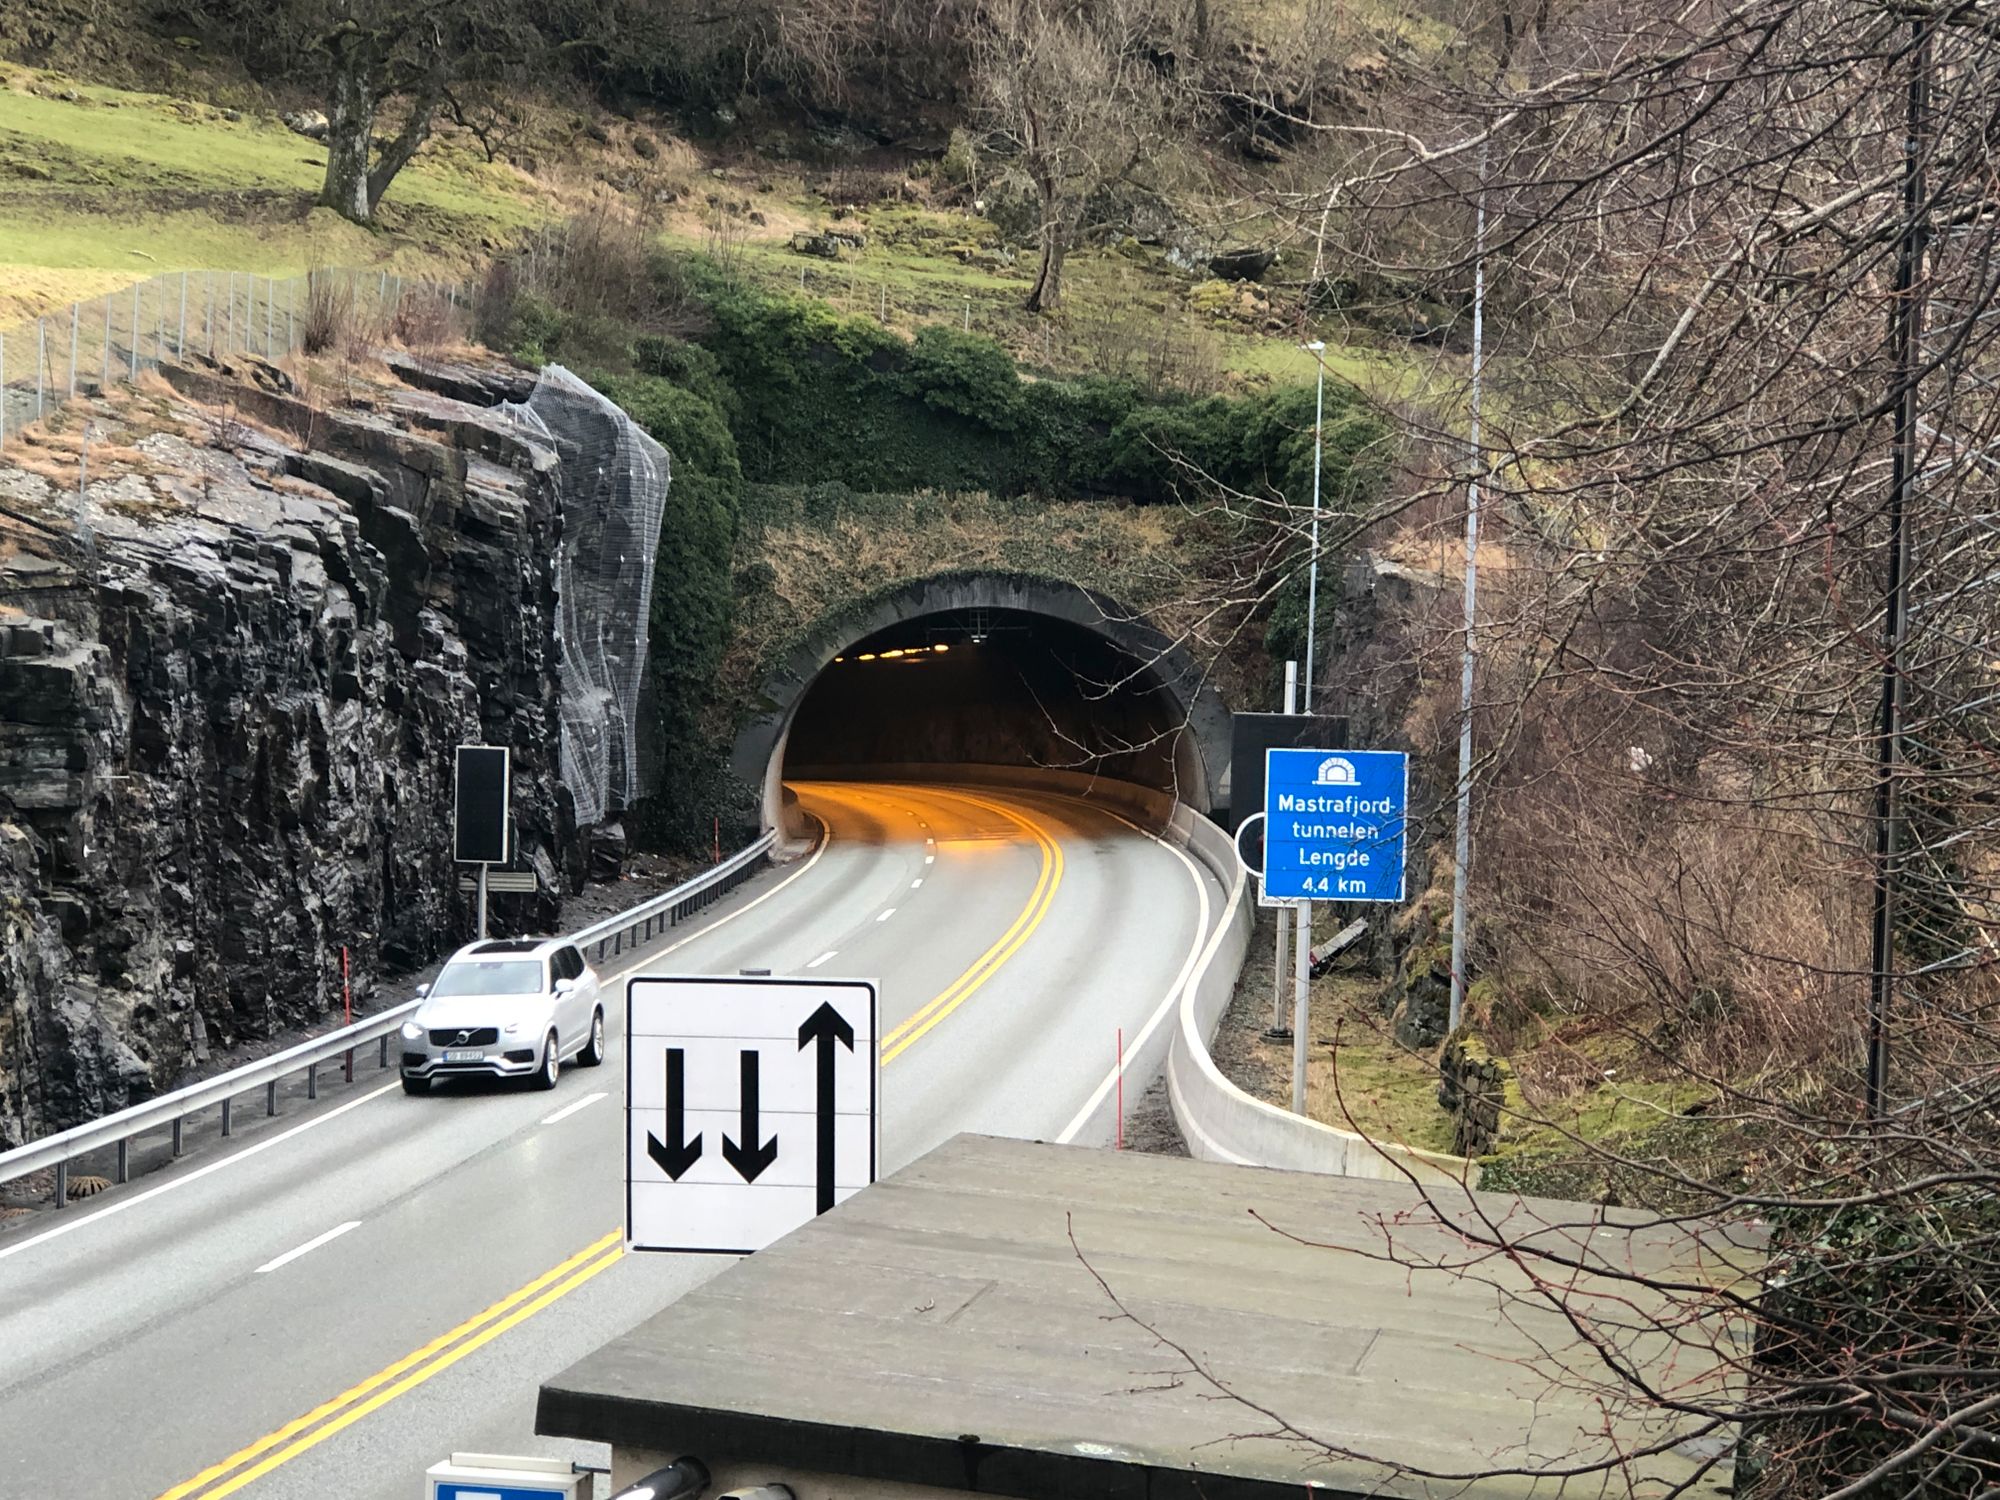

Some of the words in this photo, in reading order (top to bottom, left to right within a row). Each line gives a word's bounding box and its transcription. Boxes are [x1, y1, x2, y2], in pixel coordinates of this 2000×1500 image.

[1278, 794, 1396, 817] Mastrafjord-
[1292, 821, 1379, 839] tunnelen
[1299, 848, 1370, 870] Lengde
[1302, 877, 1329, 893] 4,4
[1338, 876, 1366, 893] km
